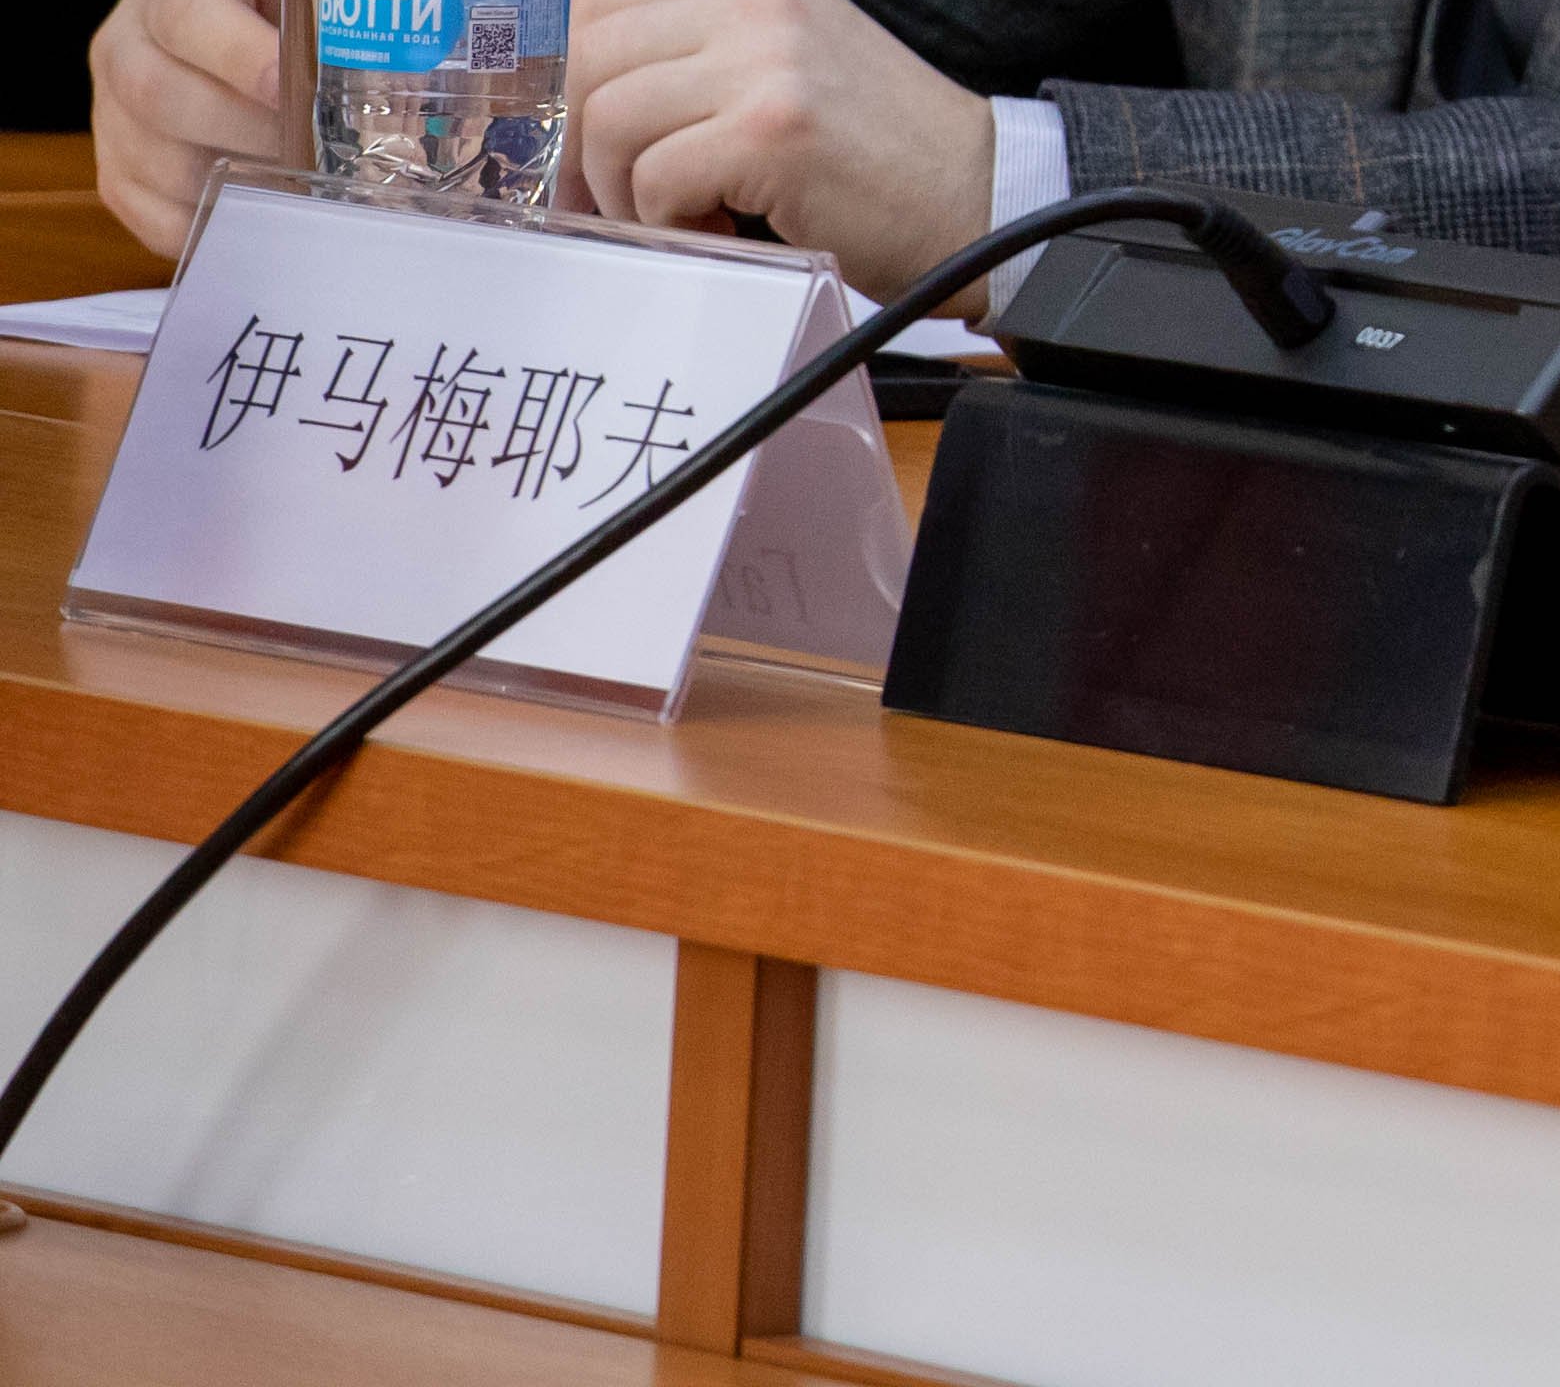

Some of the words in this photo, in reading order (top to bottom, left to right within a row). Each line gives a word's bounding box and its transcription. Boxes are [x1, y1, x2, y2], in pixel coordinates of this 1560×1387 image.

[199, 314, 697, 510] 伊马梅耶夫
